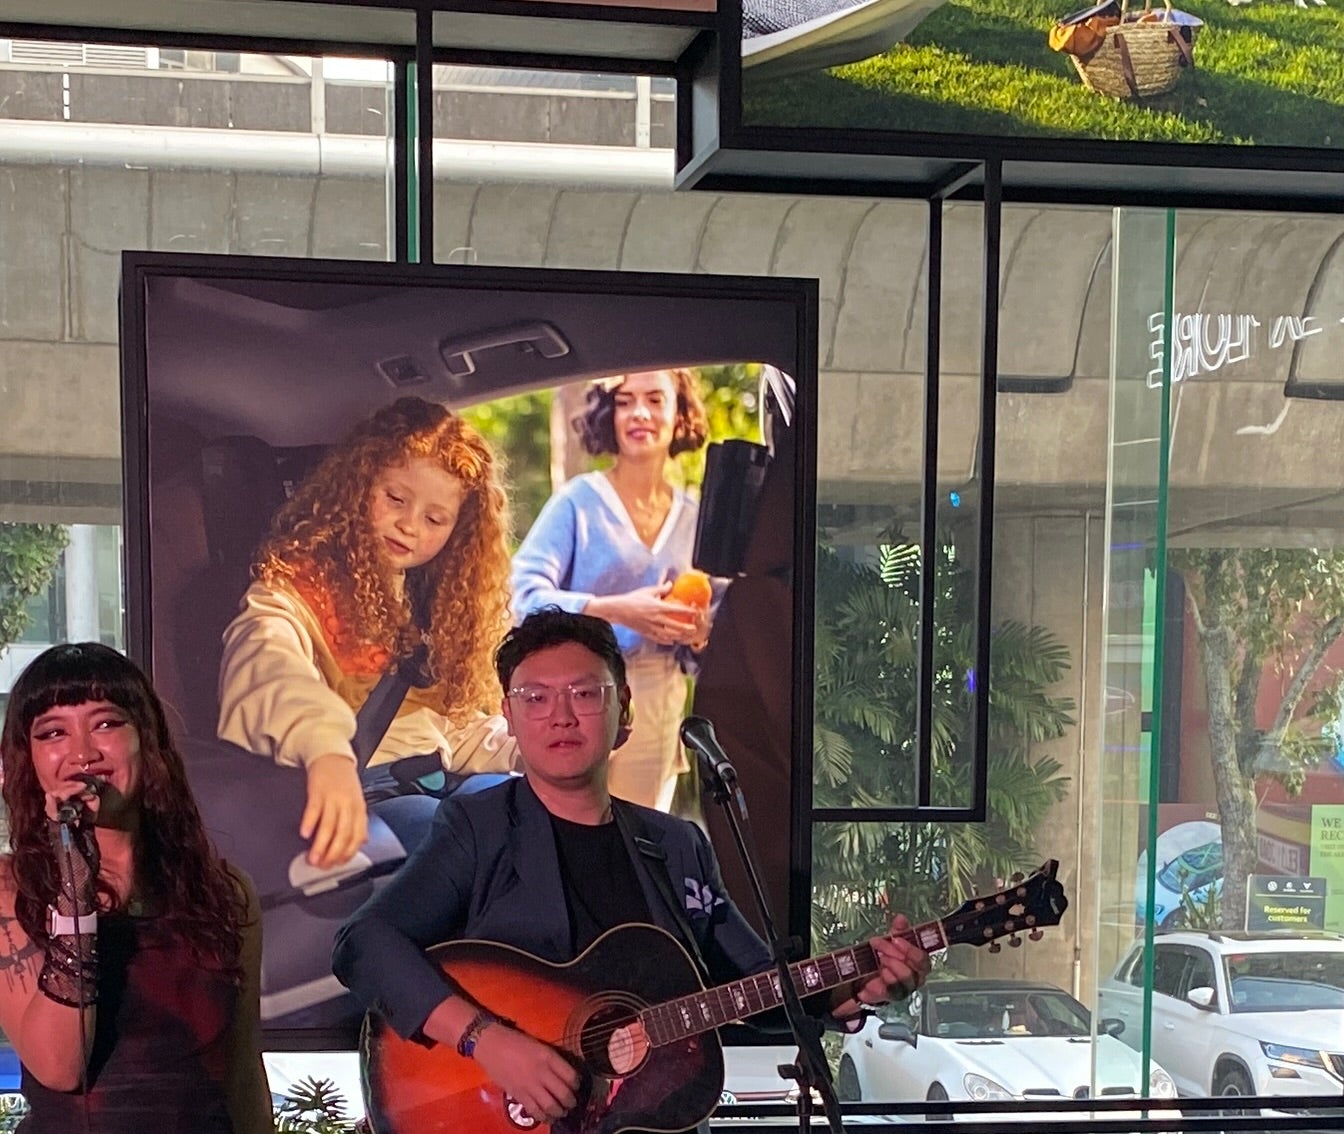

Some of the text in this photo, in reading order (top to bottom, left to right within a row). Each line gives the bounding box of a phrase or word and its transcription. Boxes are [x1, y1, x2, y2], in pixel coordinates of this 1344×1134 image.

[1264, 905, 1312, 915] Reserved for
[1267, 914, 1308, 922] customers
